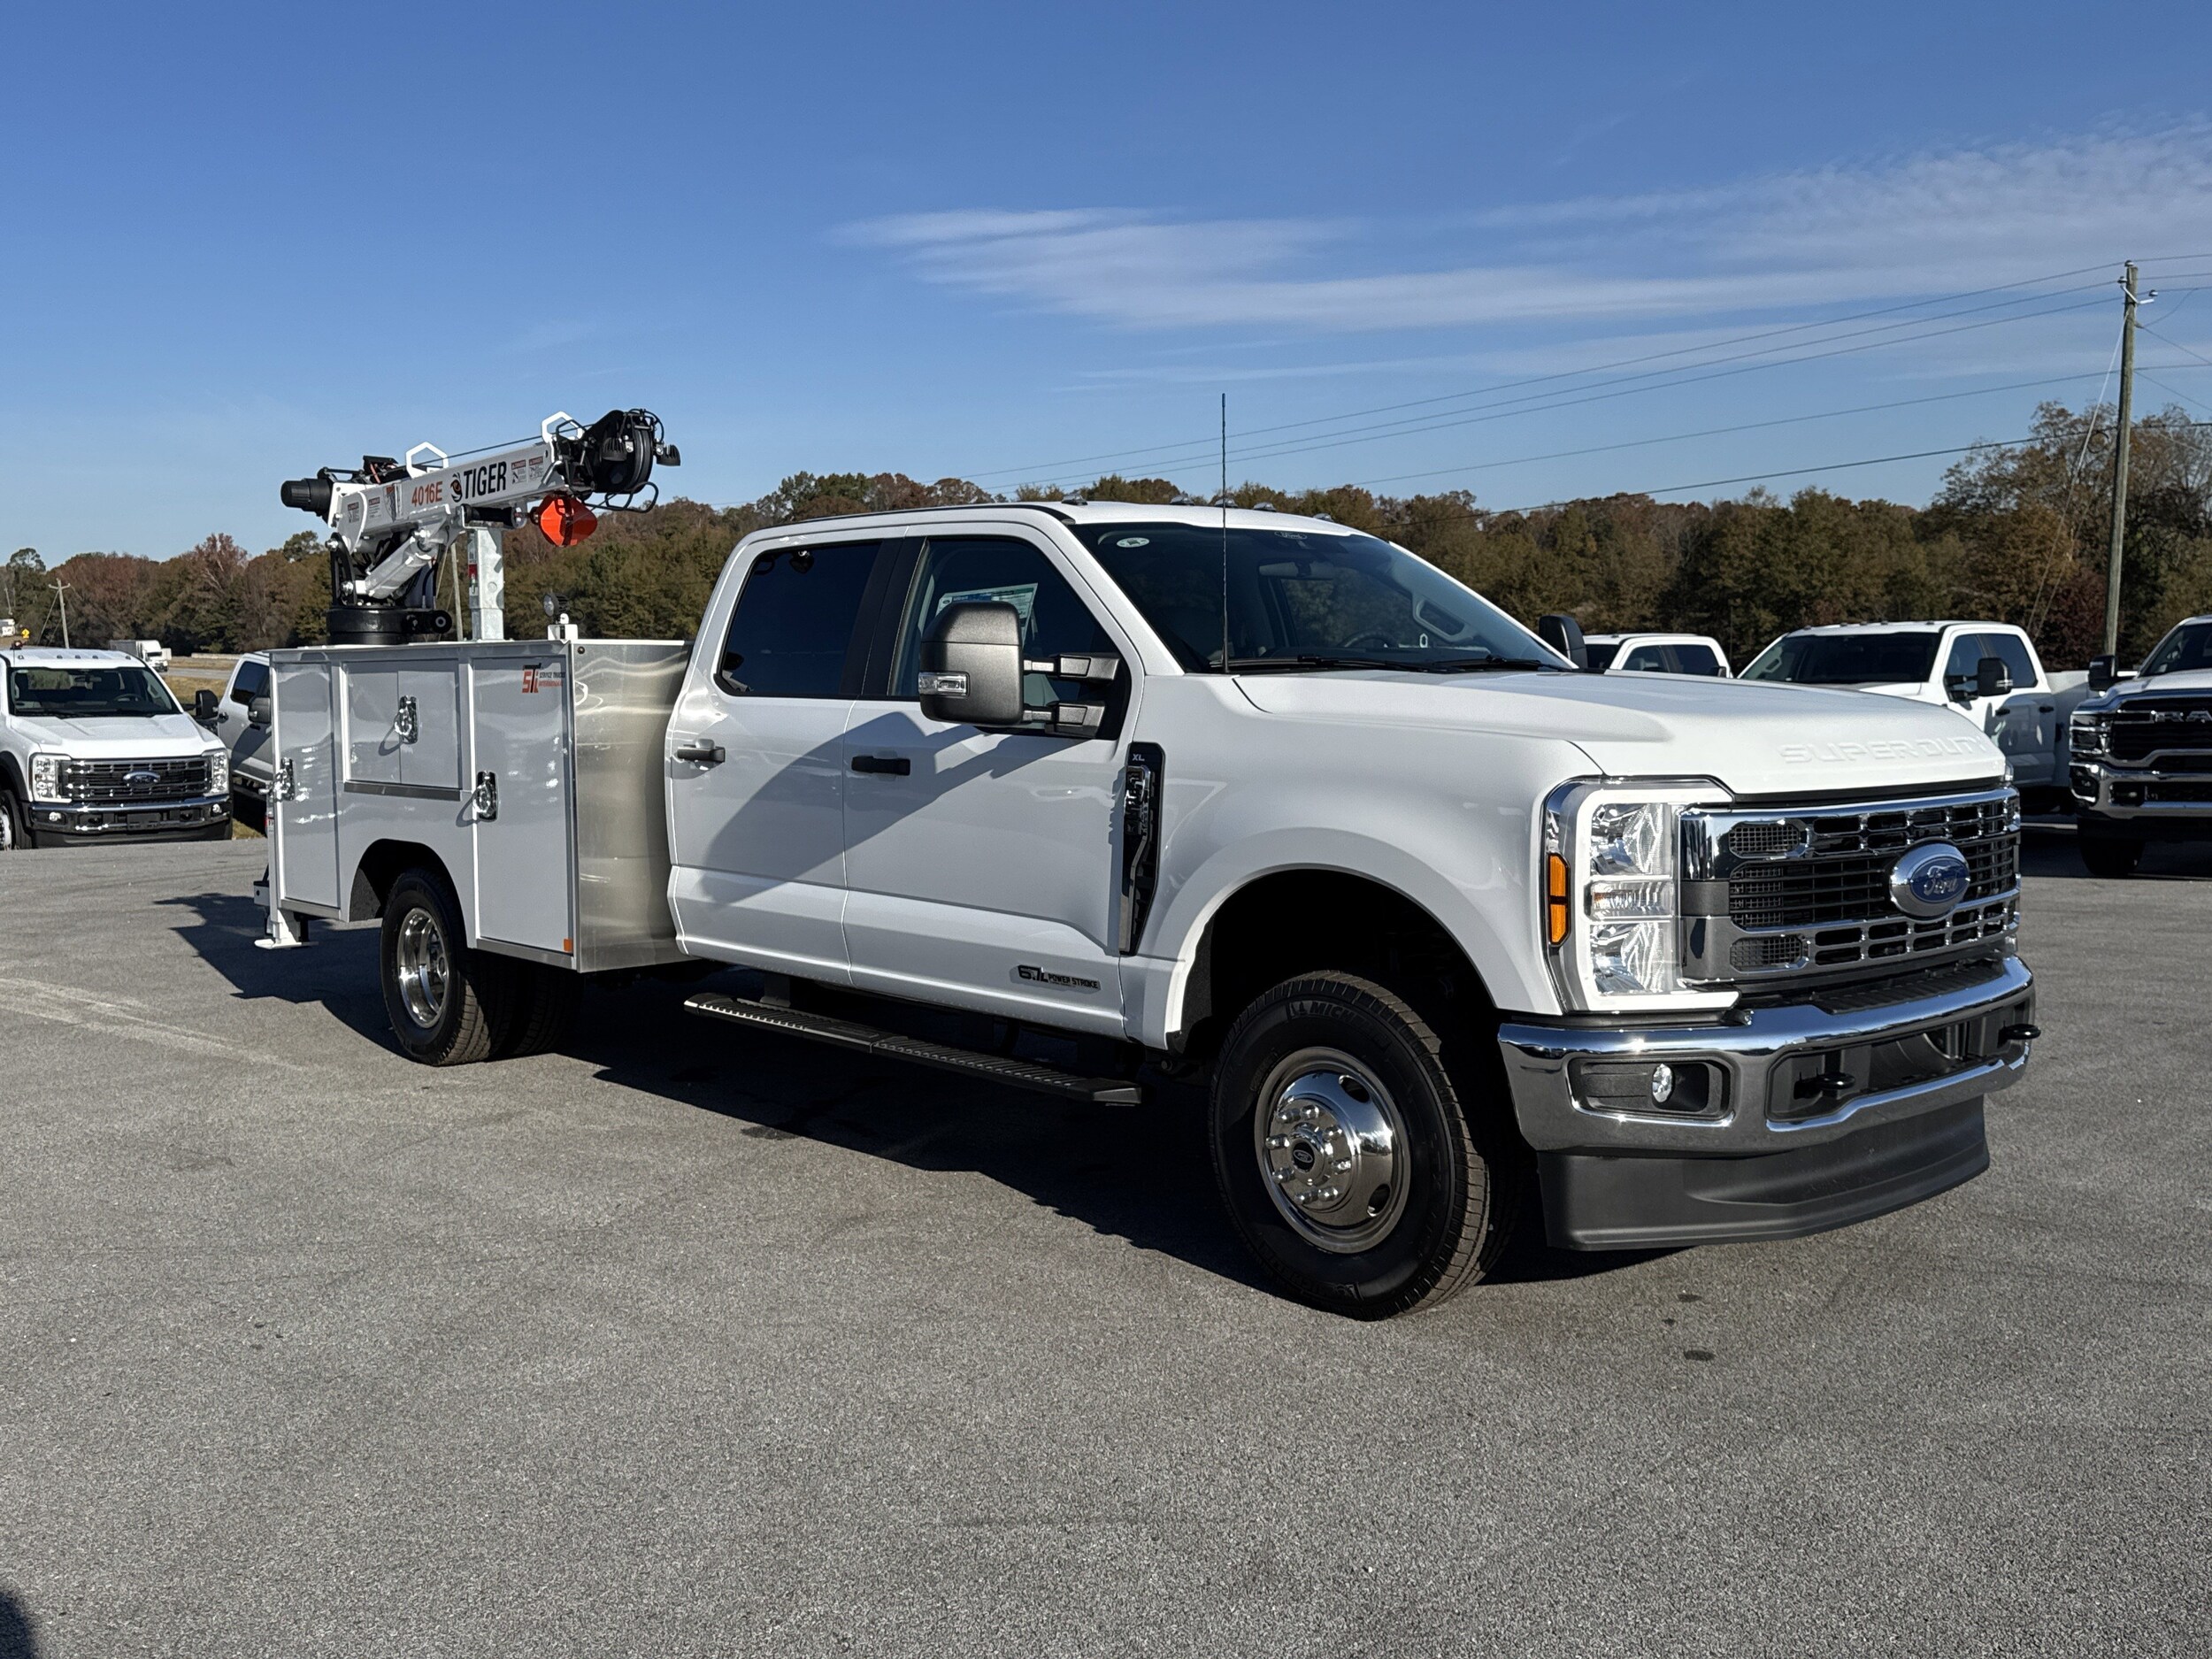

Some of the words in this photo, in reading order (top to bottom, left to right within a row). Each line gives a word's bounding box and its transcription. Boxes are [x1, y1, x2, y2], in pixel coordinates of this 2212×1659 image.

[411, 481, 442, 507] 4016E
[464, 461, 507, 499] TIGER
[1133, 753, 1145, 762] XL
[1779, 741, 1918, 763] SUPER
[1924, 864, 1959, 895] Ford
[1048, 973, 1071, 985] POWER
[1071, 977, 1099, 989] STROKE
